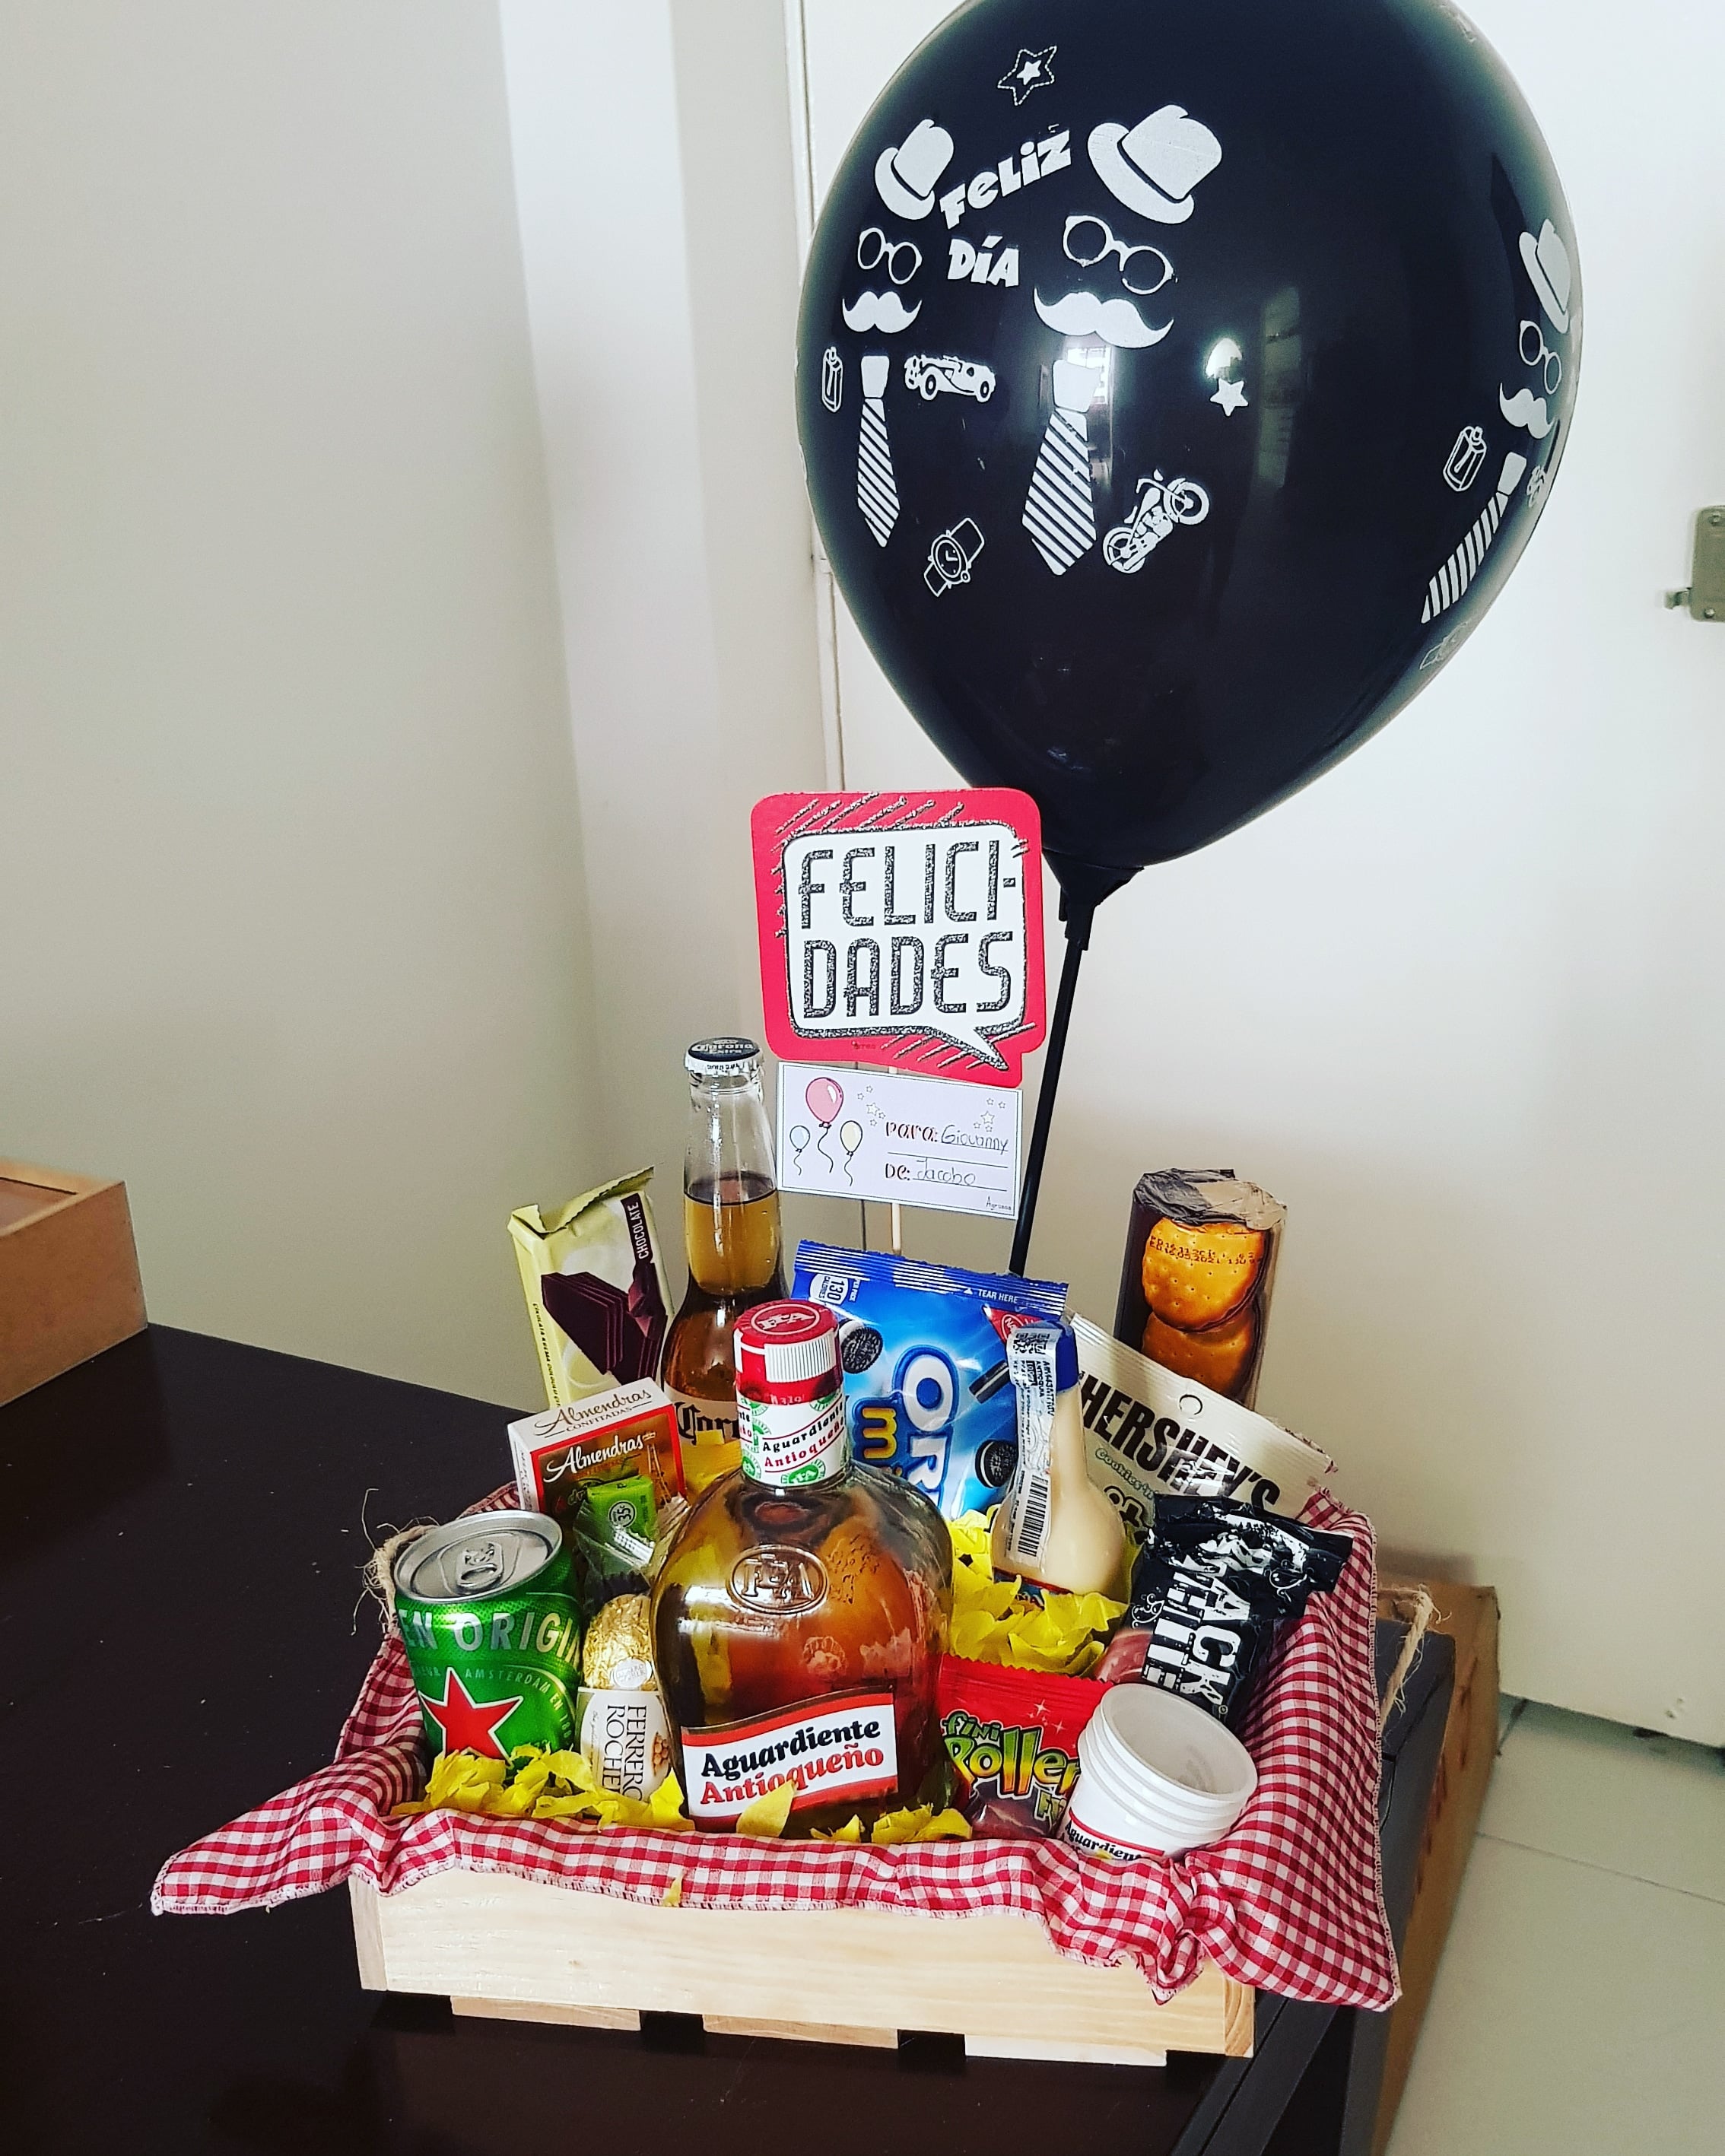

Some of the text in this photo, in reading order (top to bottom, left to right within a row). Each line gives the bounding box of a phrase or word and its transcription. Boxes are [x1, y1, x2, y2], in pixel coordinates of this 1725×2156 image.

[799, 840, 1016, 929] FELICI-
[804, 931, 1013, 1019] DADES
[626, 1202, 650, 1259] CHOCOLATE
[827, 1281, 845, 1301] 130
[978, 1288, 1019, 1304] TEAR HERE
[534, 1388, 653, 1437] Almendras
[566, 1406, 634, 1433] CONFITADAS
[542, 1432, 644, 1484] Almendras
[1080, 1373, 1281, 1511] HERSHEY'S
[465, 1667, 551, 1695] AMSTERDAM
[549, 1693, 564, 1711] EN
[700, 1719, 881, 1781] Aguardiente
[700, 1742, 884, 1805] Antioqueño
